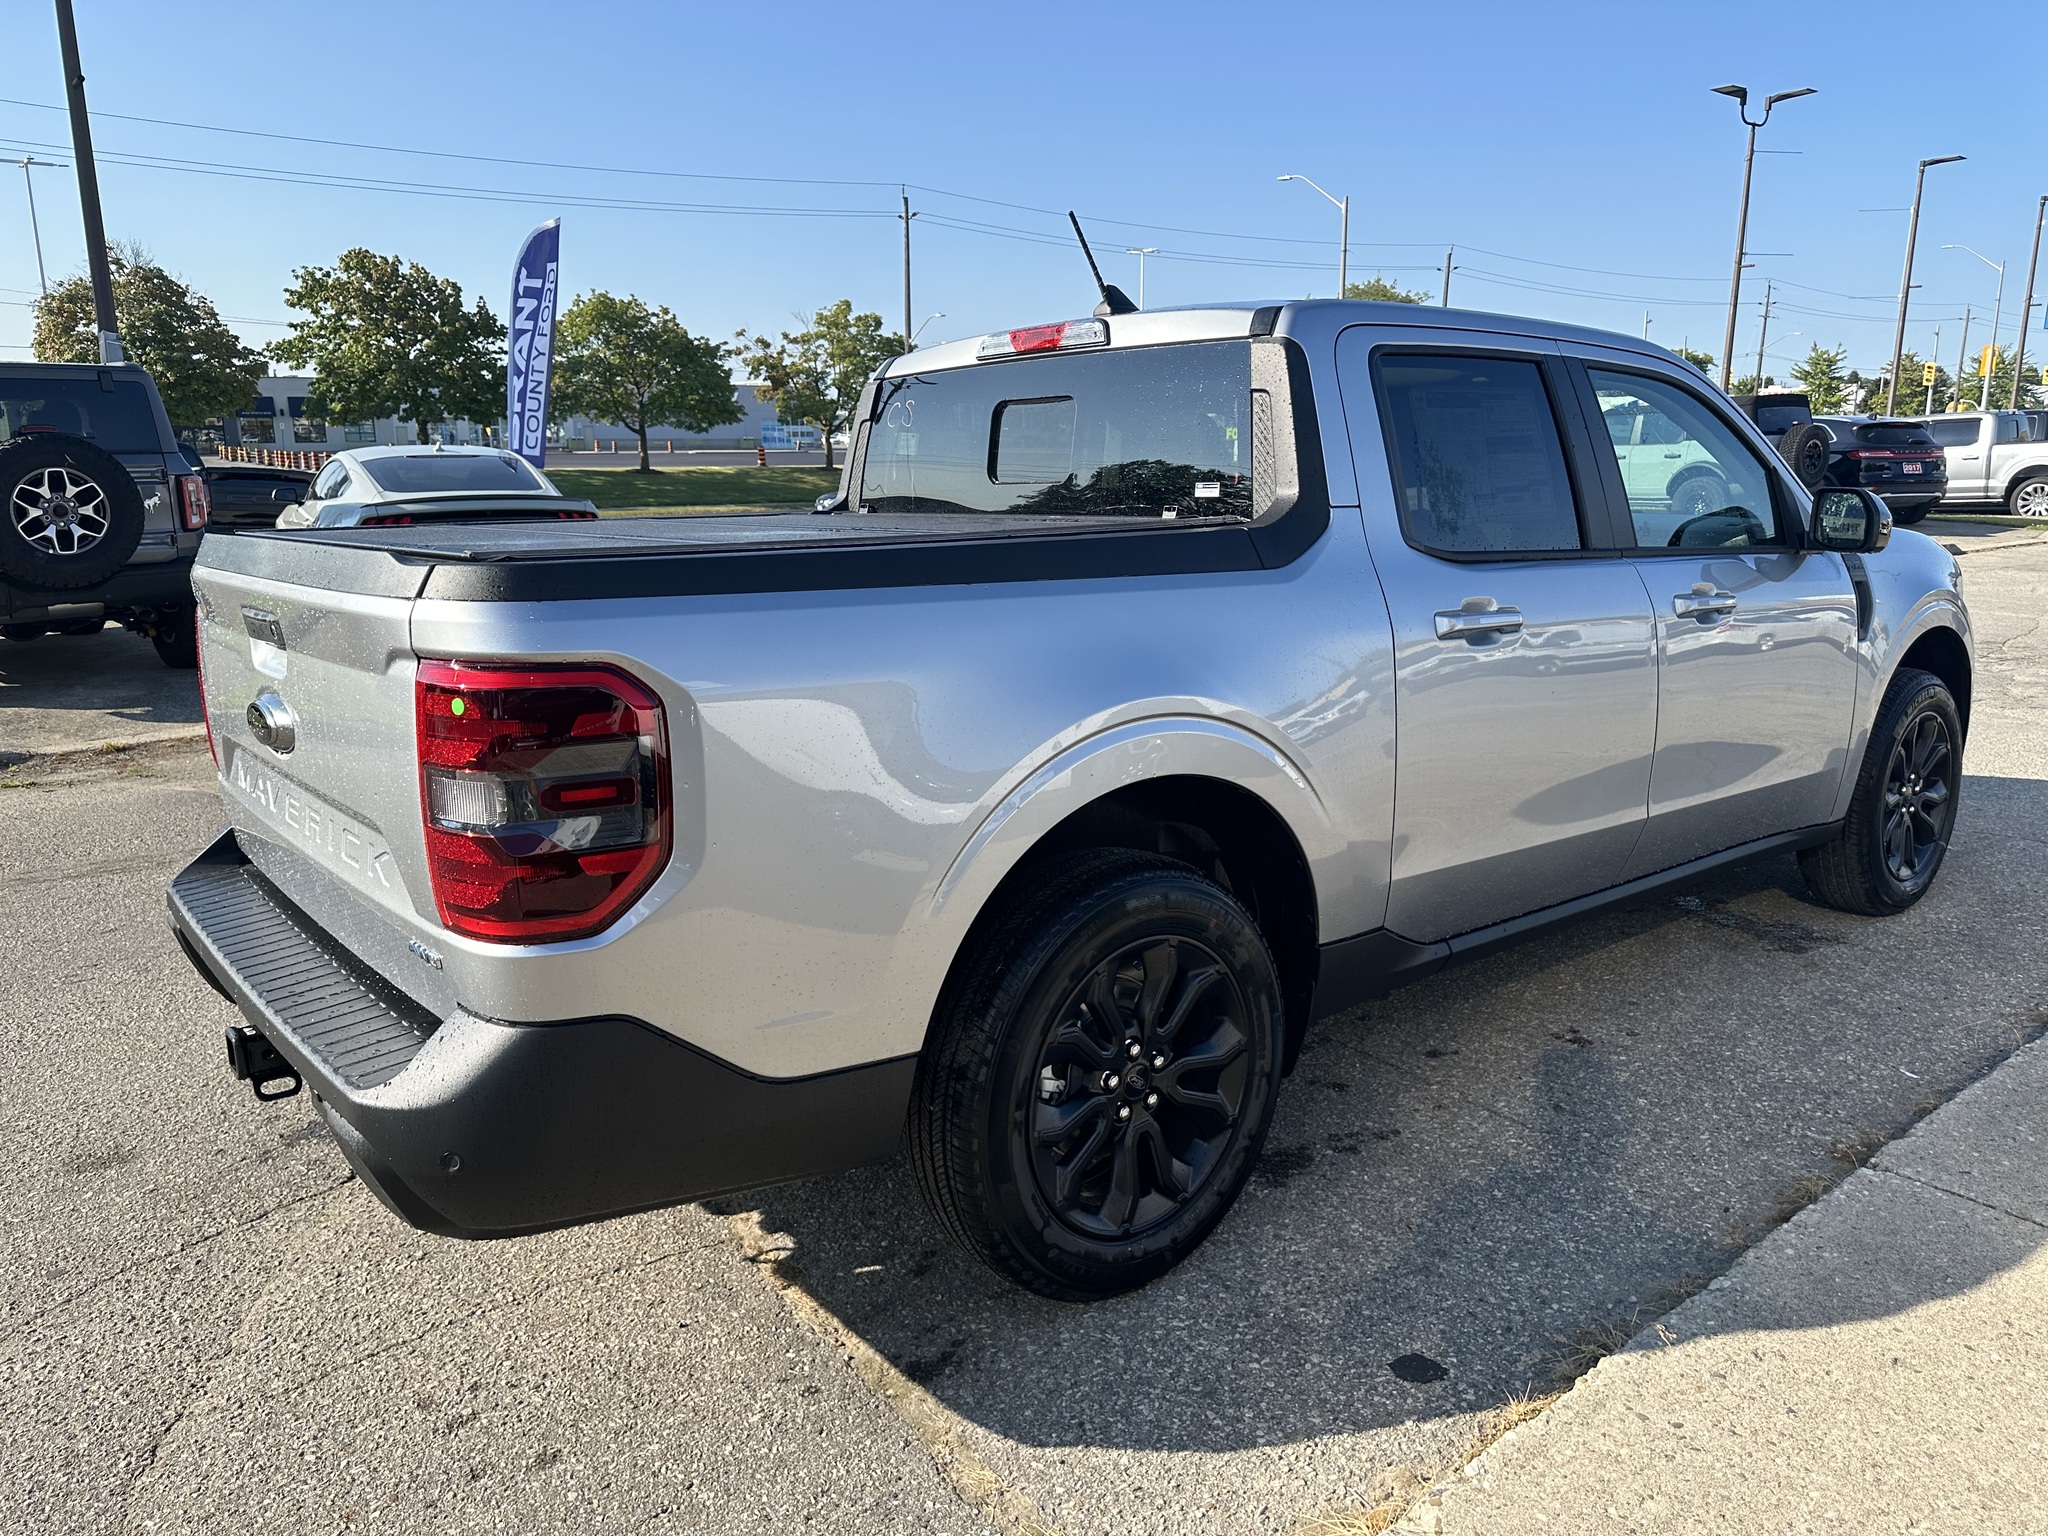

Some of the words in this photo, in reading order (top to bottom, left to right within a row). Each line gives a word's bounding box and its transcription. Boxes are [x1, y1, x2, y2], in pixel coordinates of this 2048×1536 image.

[525, 345, 546, 450] COUNTY
[537, 268, 556, 338] FORD
[237, 760, 391, 889] MAVERICK
